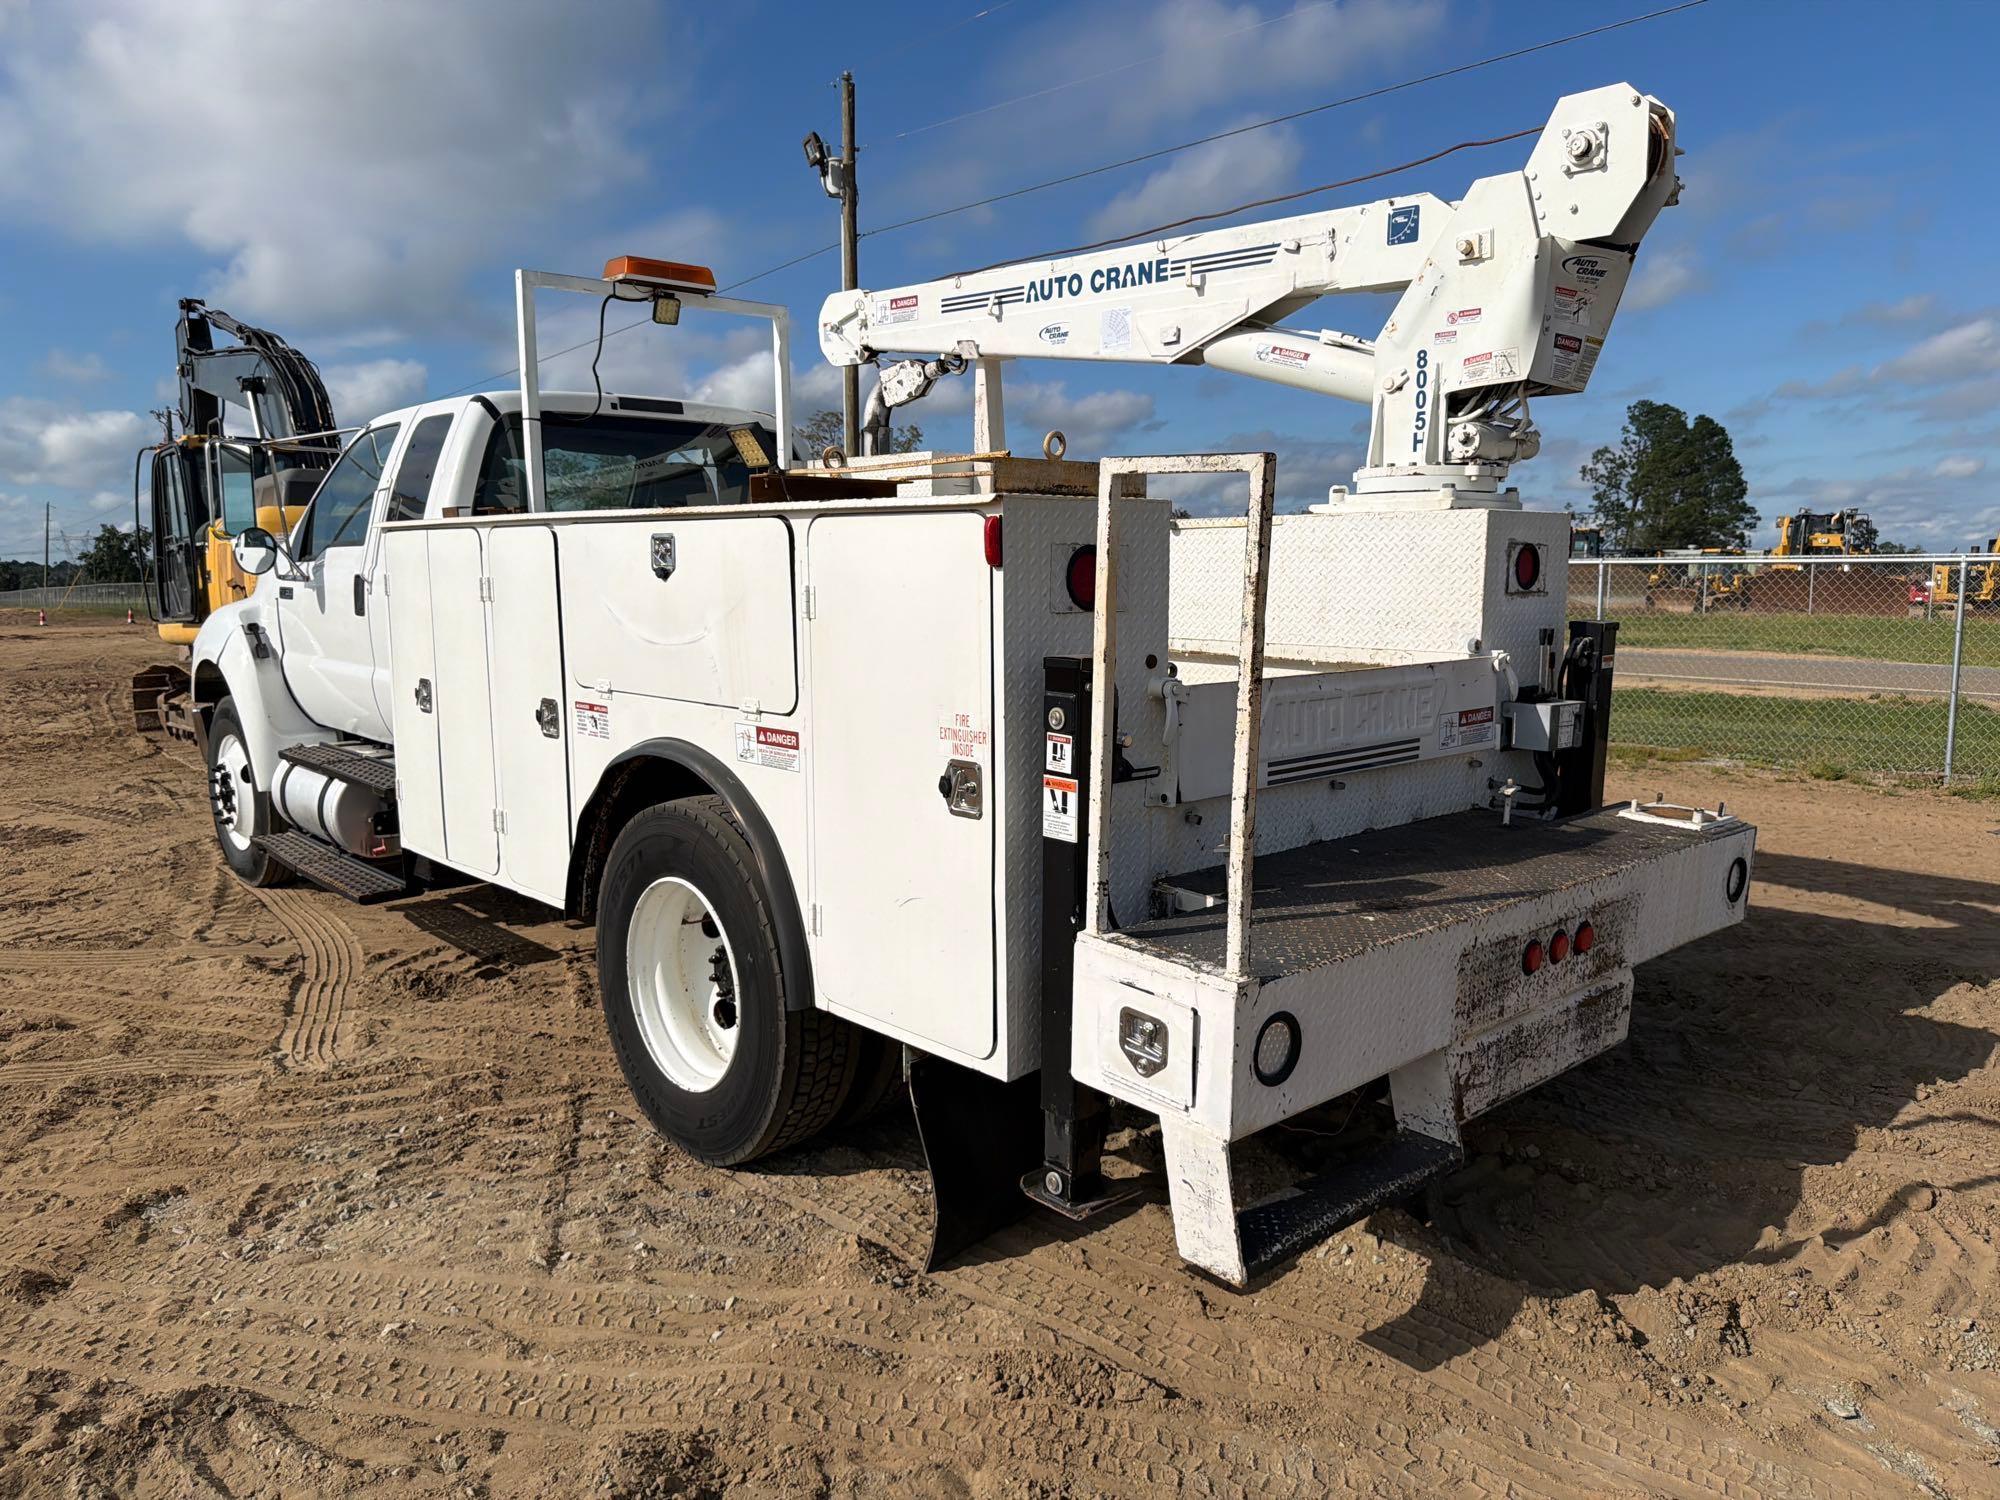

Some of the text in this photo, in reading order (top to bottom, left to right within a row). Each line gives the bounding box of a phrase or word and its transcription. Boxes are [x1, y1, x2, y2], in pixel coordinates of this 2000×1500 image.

[1572, 258, 1599, 268] AUTO
[1576, 267, 1608, 278] CRANE
[1026, 258, 1170, 303] AUTO CRANE
[896, 298, 917, 308] DANGER
[1044, 326, 1061, 334] AUTO
[1049, 331, 1069, 339] CRANE
[1557, 336, 1580, 350] DANGER
[1281, 349, 1306, 360] DANGER
[1469, 353, 1491, 364] DANGER
[955, 713, 970, 728] FIRE
[1467, 710, 1491, 723] DANGER
[766, 731, 797, 747] DANGER
[939, 726, 987, 745] EXTINGUISHER
[952, 742, 974, 758] INSIDE
